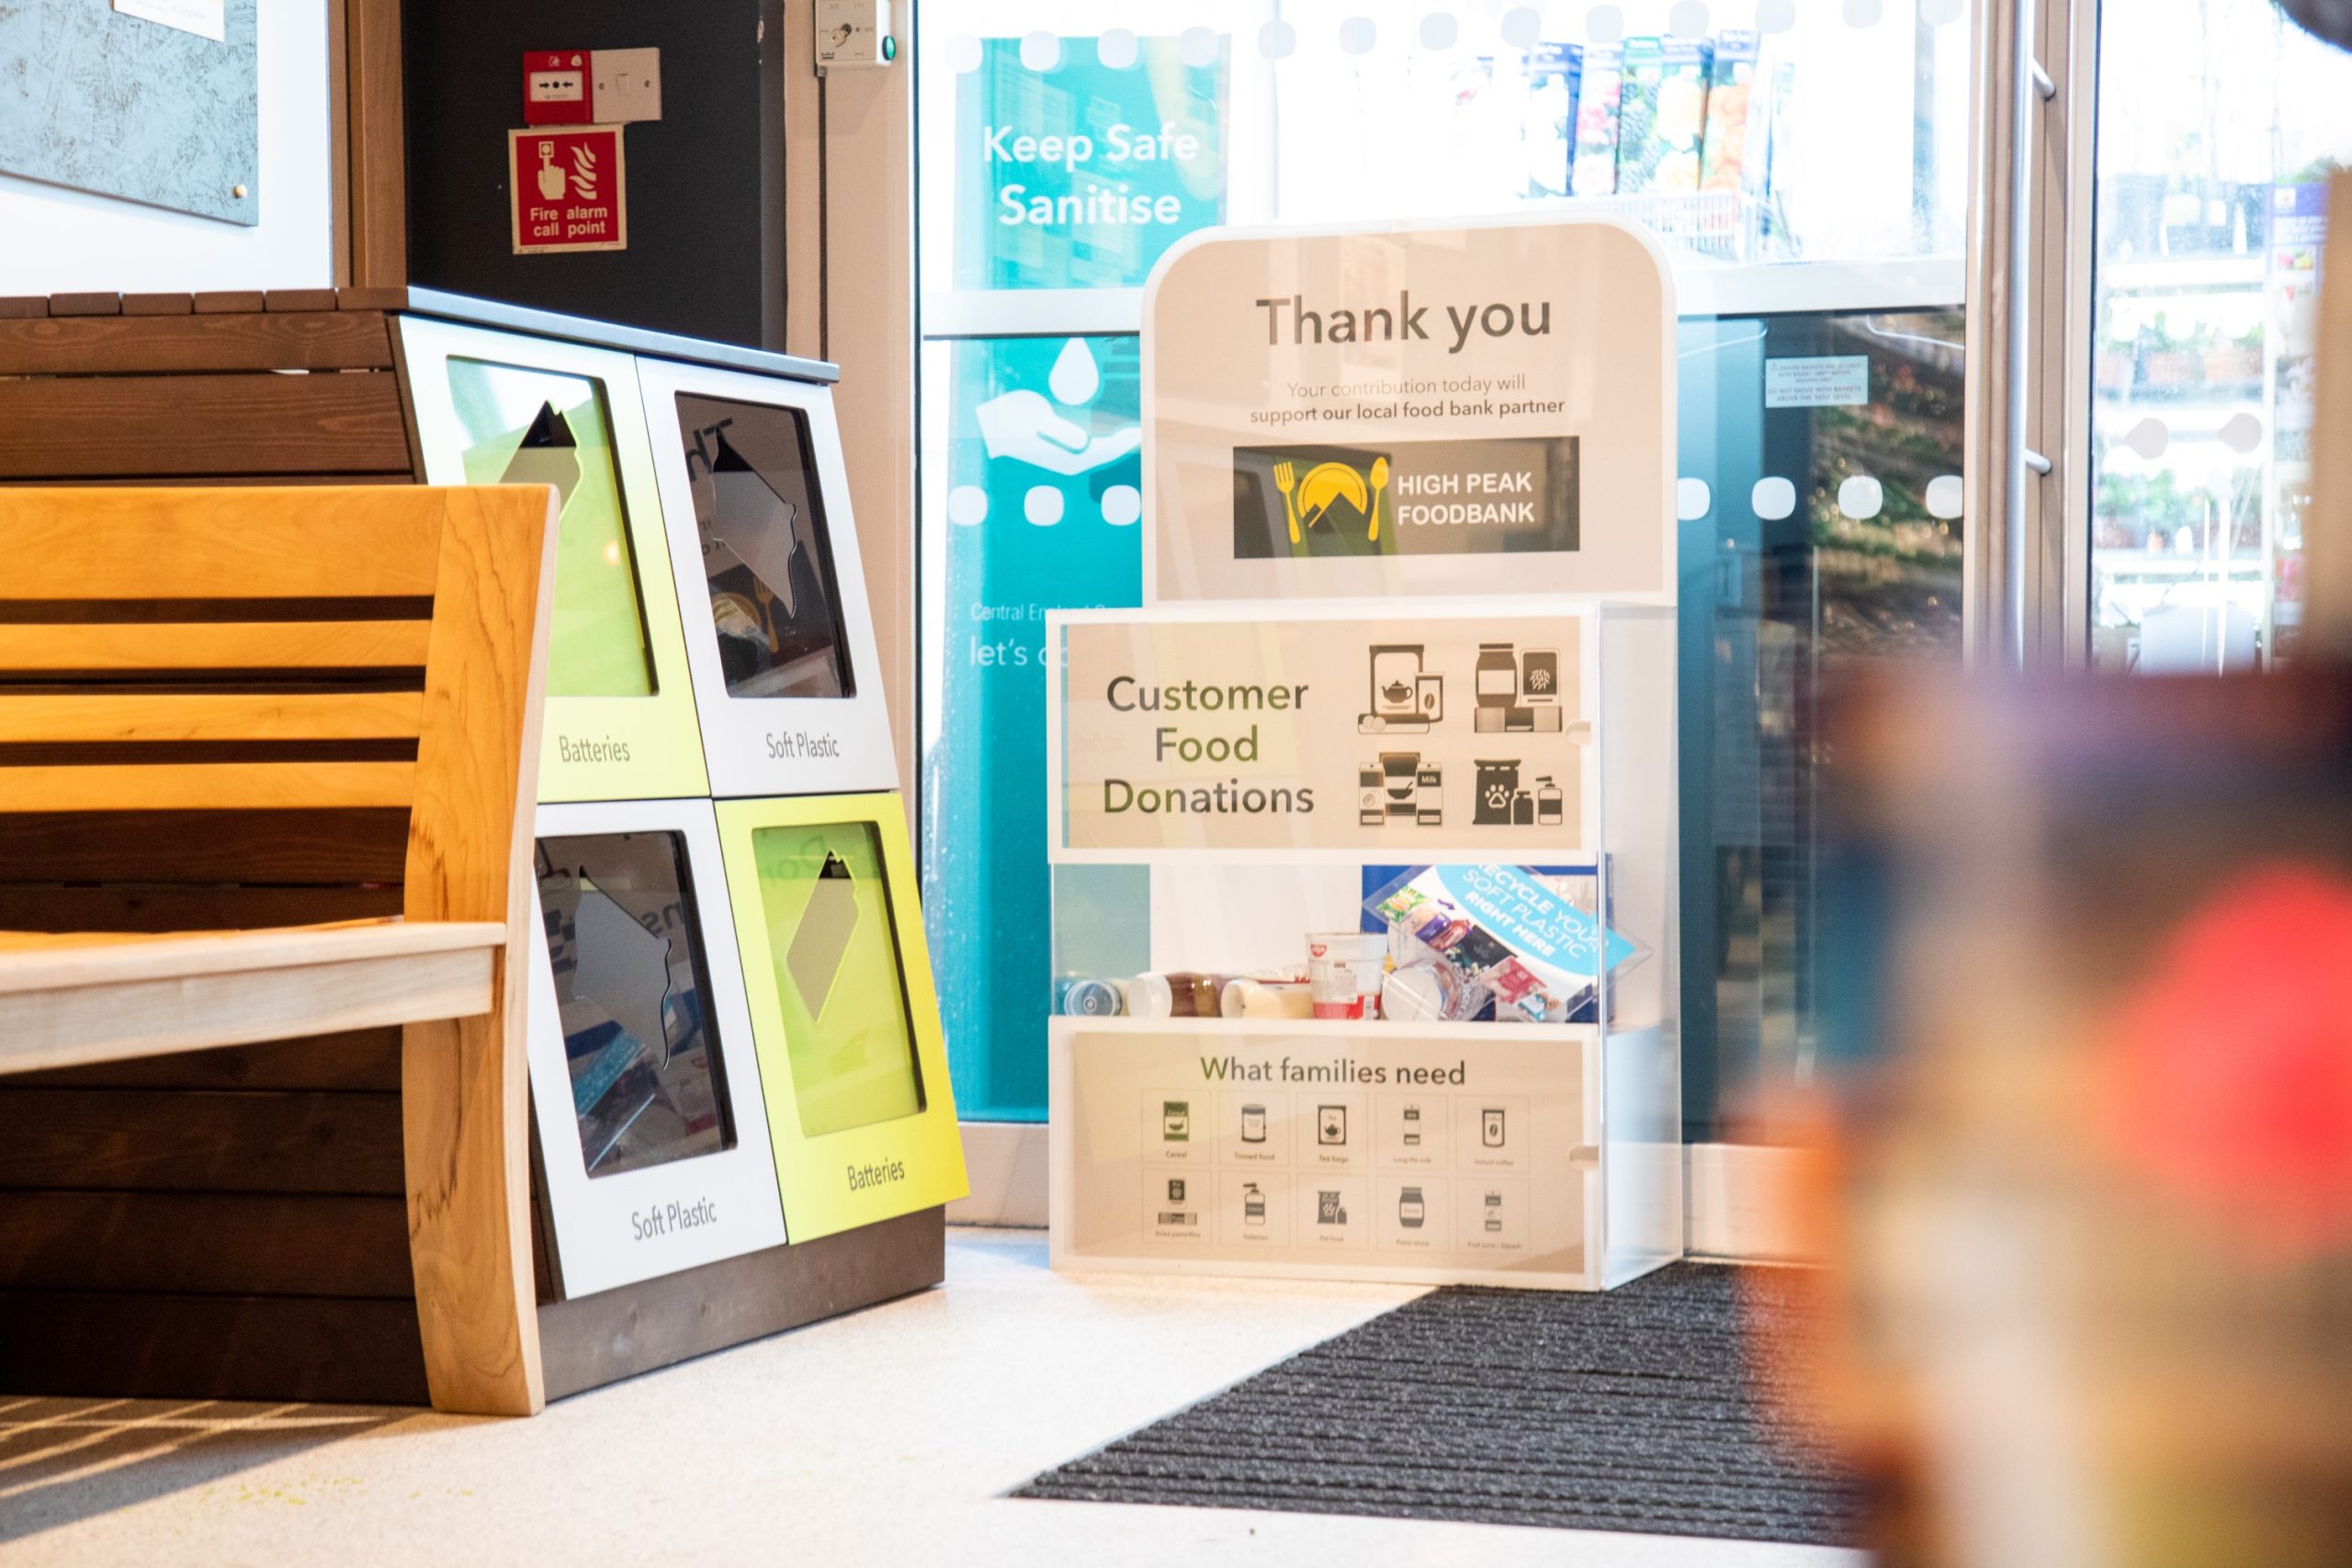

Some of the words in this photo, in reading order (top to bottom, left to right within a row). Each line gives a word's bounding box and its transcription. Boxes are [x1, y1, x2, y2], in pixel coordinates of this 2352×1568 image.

[984, 125, 1093, 173] Keep
[1105, 121, 1199, 162] Safe
[530, 207, 559, 220] Fire
[567, 206, 607, 220] alarm
[999, 184, 1182, 225] Sanitise
[534, 221, 559, 237] call
[568, 220, 605, 238] point
[1256, 289, 1430, 345] Thank
[1446, 302, 1550, 354] you
[1287, 382, 1327, 398] Your
[1331, 378, 1436, 397] contribution
[1442, 376, 1492, 396] today
[1497, 374, 1525, 390] will
[1250, 407, 1318, 426] support
[1323, 407, 1351, 421] our
[1357, 403, 1397, 419] local
[1403, 401, 1443, 418] food
[1450, 400, 1494, 416] bank
[1499, 399, 1565, 419] partner
[1398, 473, 1459, 495] HIGH
[1466, 472, 1532, 493] PEAK
[1398, 502, 1534, 525] FOODBANK
[970, 602, 1024, 621] Central
[1107, 675, 1308, 712] Customer
[559, 735, 630, 763] Batteries
[766, 732, 796, 760] Soft
[796, 732, 840, 758] Plastic
[1157, 724, 1258, 762] Food
[1421, 775, 1437, 784] Milk
[1104, 778, 1314, 813] Donations
[1463, 869, 1515, 904] SOFT
[1511, 903, 1588, 958] PLASTIC
[1465, 891, 1516, 927] RIGHT
[1512, 924, 1556, 957] HERE
[1200, 1056, 1272, 1081] What
[1280, 1056, 1387, 1083] families
[1396, 1060, 1465, 1085] need
[1165, 1150, 1188, 1158] Cereal
[847, 1156, 905, 1191] Batteries
[631, 1205, 665, 1241] Soft
[666, 1196, 718, 1233] Plastic
